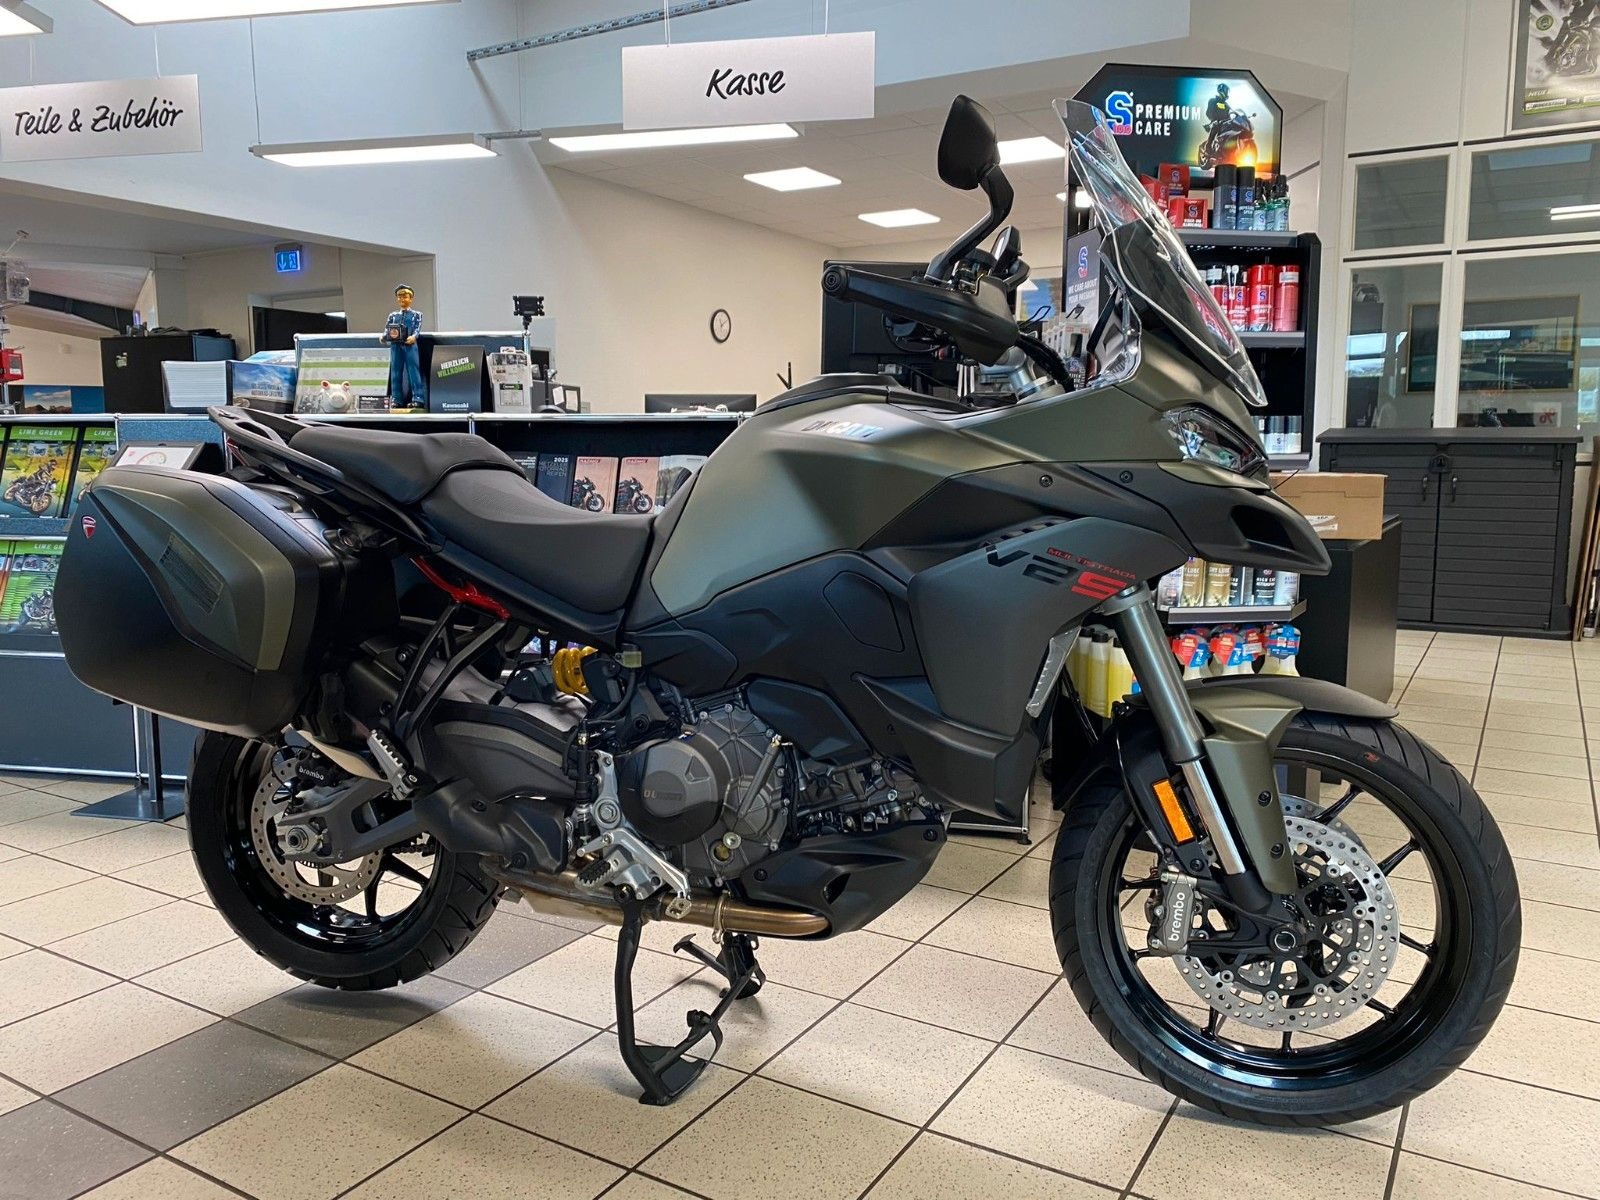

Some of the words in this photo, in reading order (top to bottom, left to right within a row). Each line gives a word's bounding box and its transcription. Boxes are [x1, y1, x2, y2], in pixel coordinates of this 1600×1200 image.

[706, 68, 786, 100] Kasse
[14, 106, 62, 136] Teile
[68, 108, 82, 132] &
[91, 96, 183, 132] Zubehör
[1135, 103, 1200, 121] PREMIUM
[1135, 121, 1171, 136] CARE
[437, 362, 475, 378] WILLKOMMEN
[440, 356, 469, 370] HERZLICH
[298, 765, 325, 781] brembo
[1168, 891, 1186, 942] brembo
